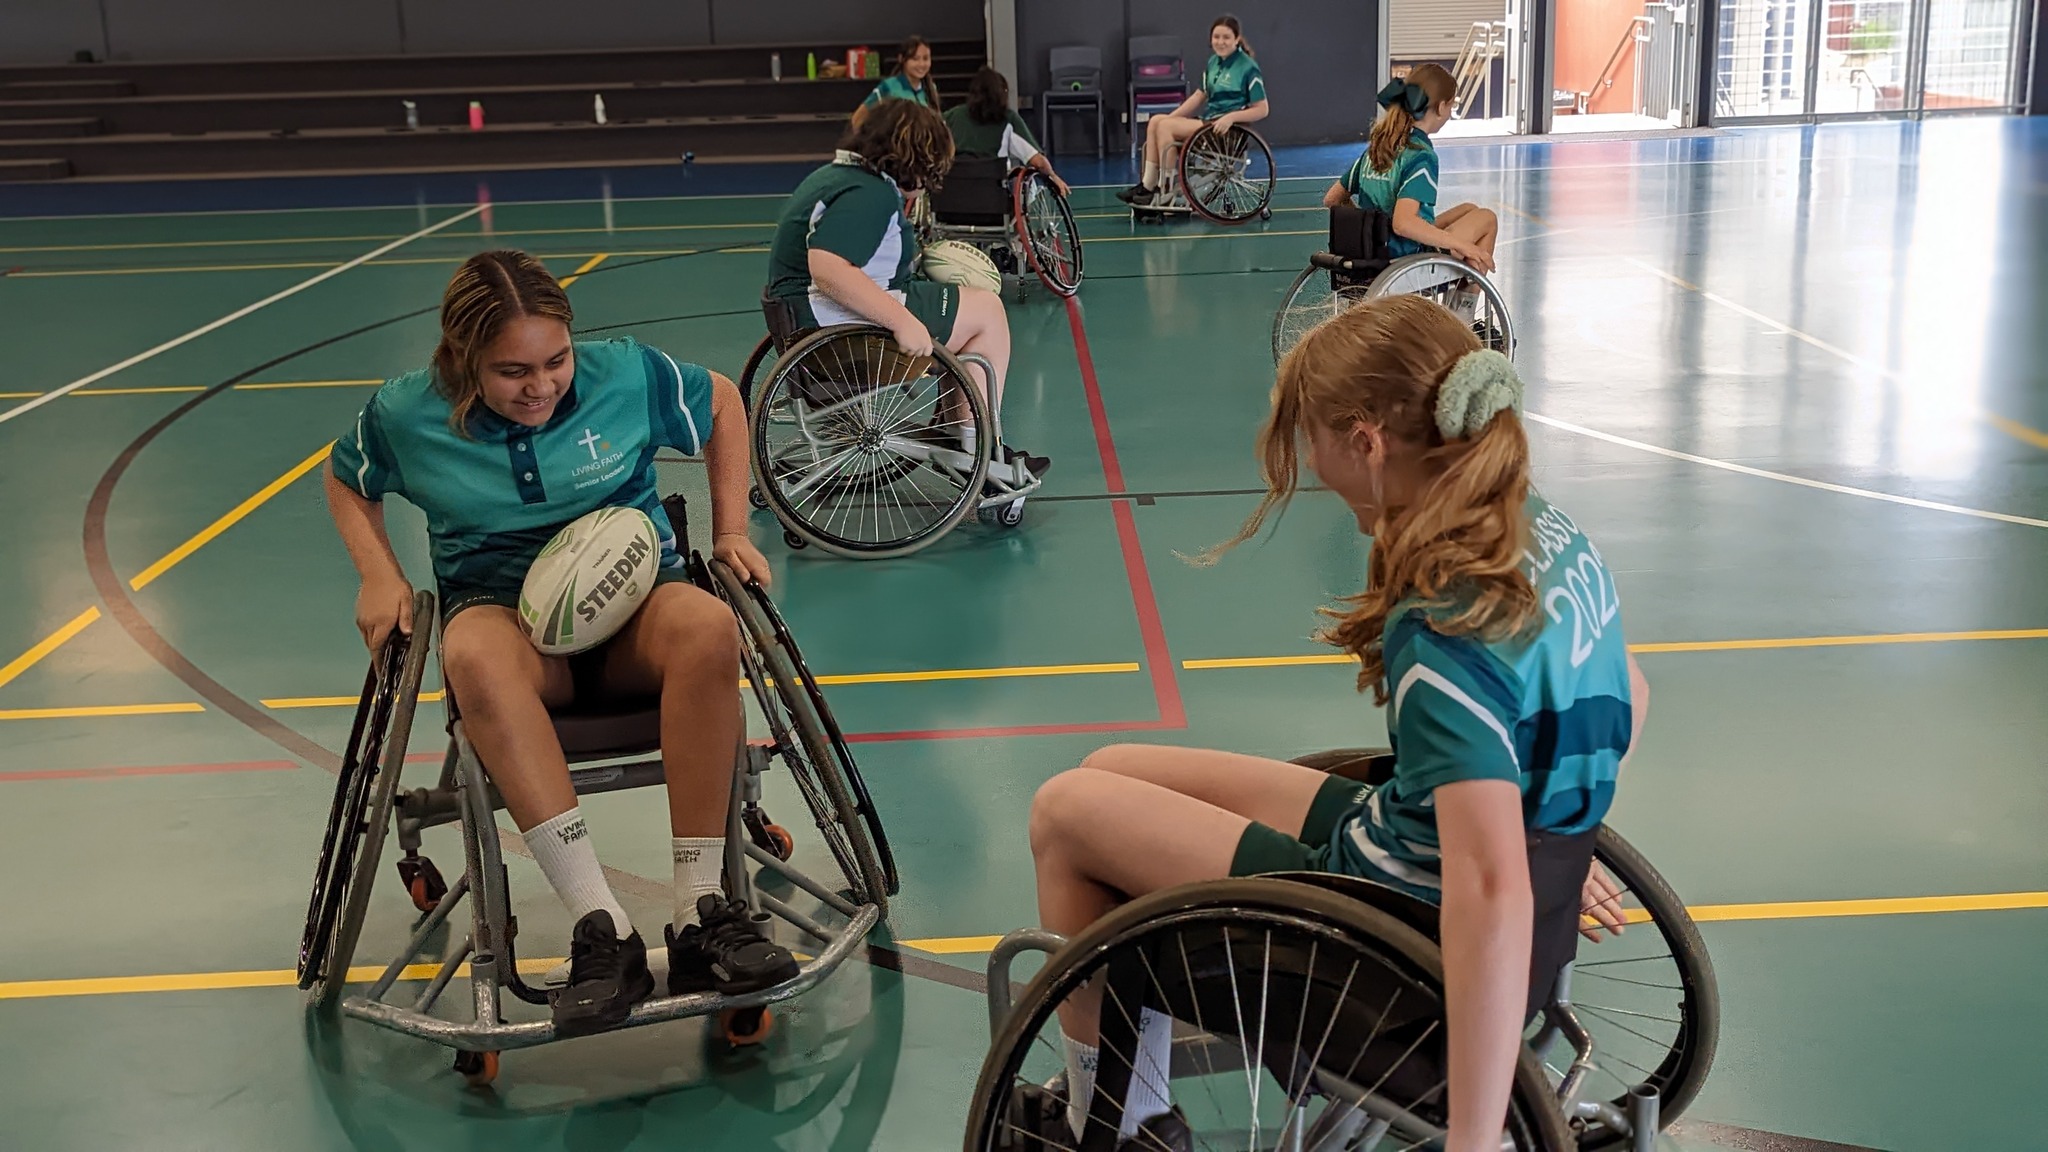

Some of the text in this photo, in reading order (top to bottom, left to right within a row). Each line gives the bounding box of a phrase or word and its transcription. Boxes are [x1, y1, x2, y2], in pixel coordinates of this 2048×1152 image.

[571, 451, 624, 477] LIVING FAITH
[574, 478, 600, 491] Senior
[1547, 504, 1579, 535] O
[576, 533, 650, 623] STEEDEN
